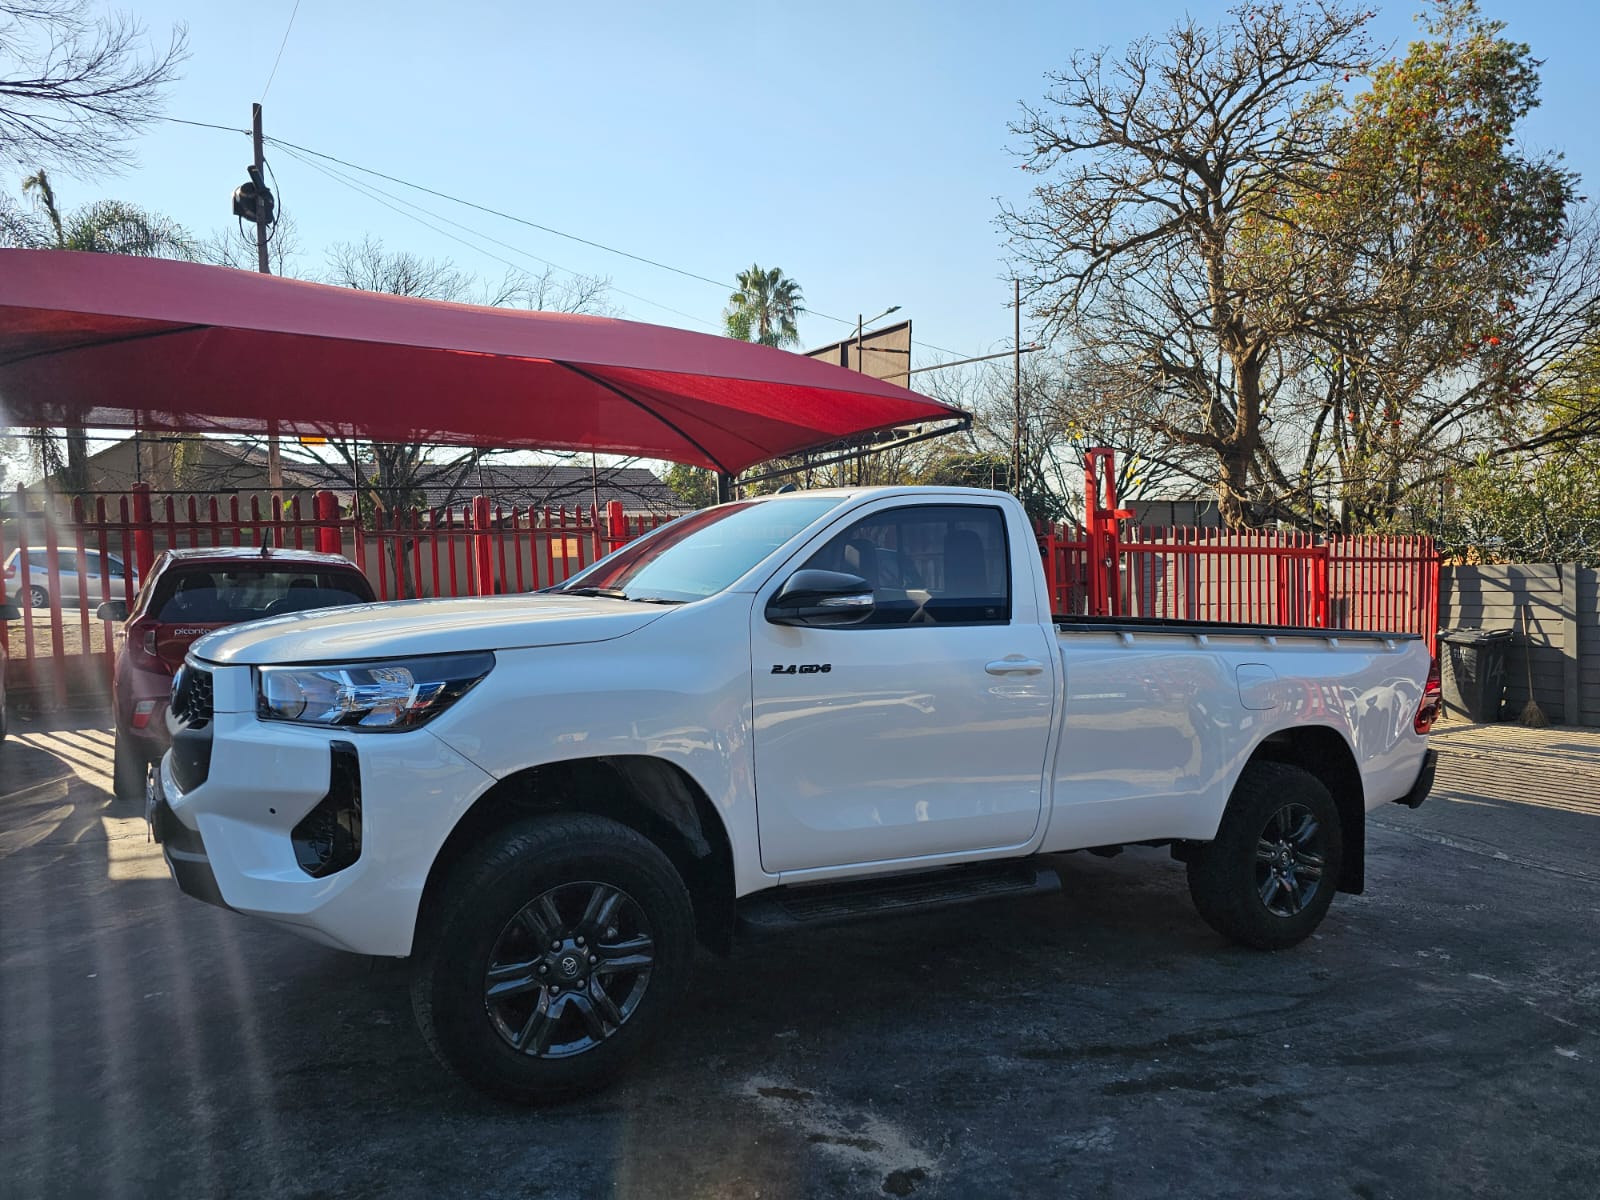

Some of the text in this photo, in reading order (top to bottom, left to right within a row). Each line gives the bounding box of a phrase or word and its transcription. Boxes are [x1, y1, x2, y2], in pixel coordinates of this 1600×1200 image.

[174, 627, 212, 637] picanto
[771, 663, 832, 675] 2.4 GD-6
